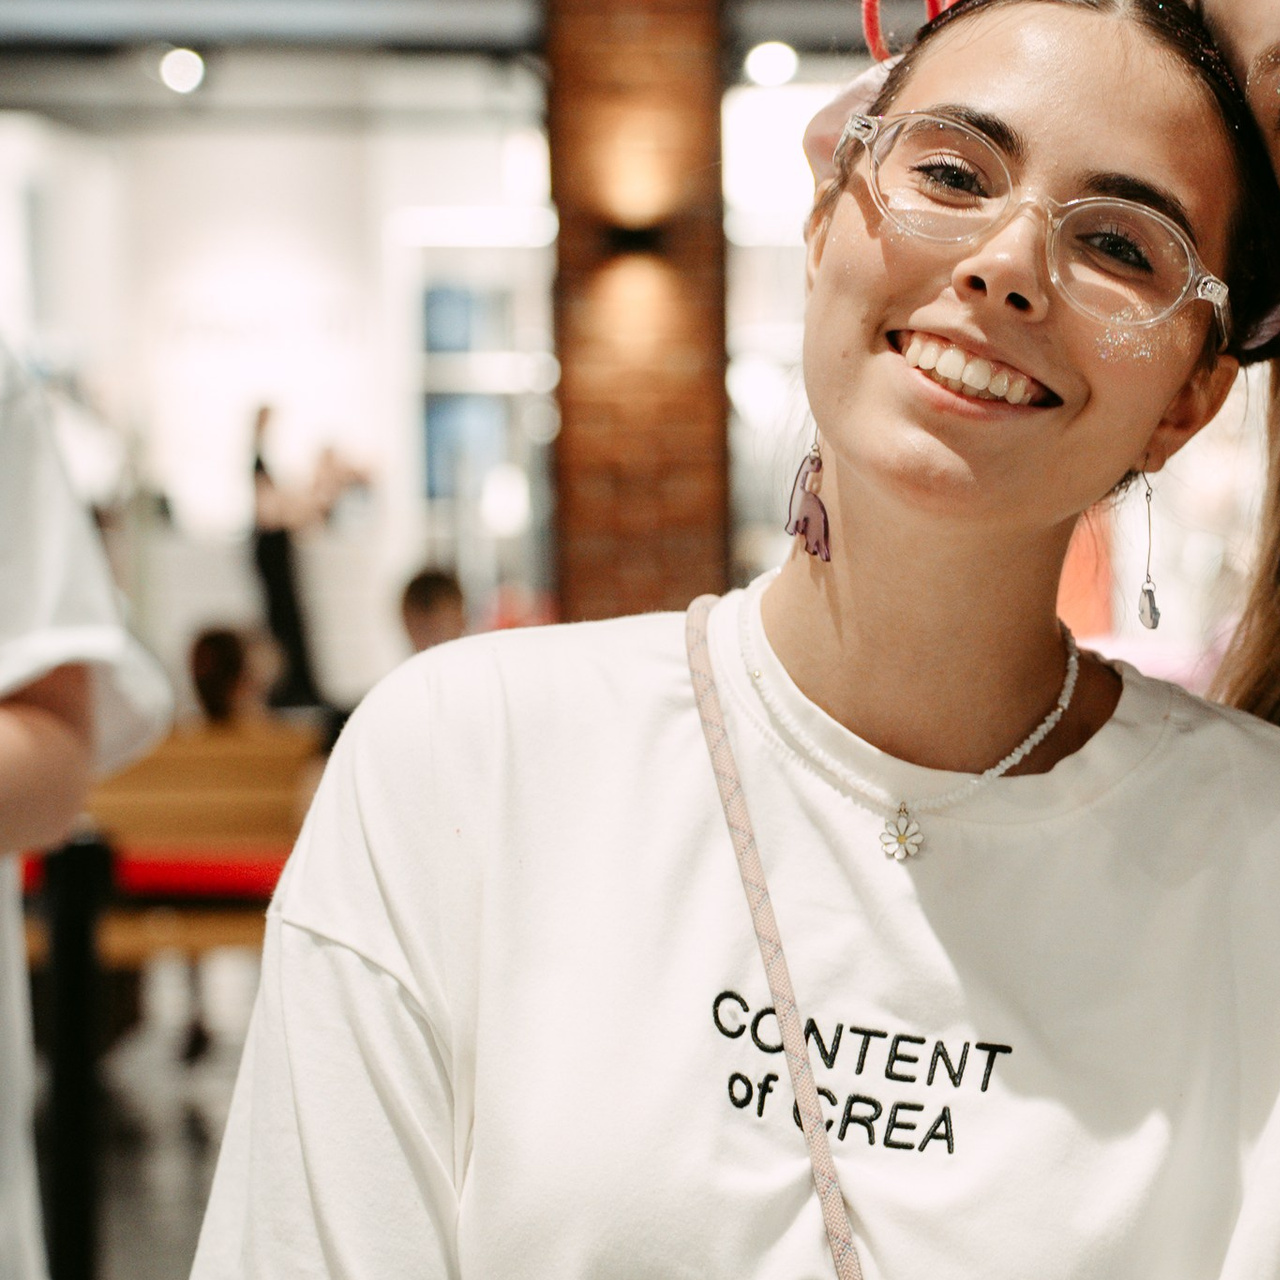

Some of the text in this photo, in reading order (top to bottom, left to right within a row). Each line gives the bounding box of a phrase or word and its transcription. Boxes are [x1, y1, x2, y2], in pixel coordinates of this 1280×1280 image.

[712, 990, 1013, 1092] CONTENT
[728, 1072, 955, 1154] of CREA
